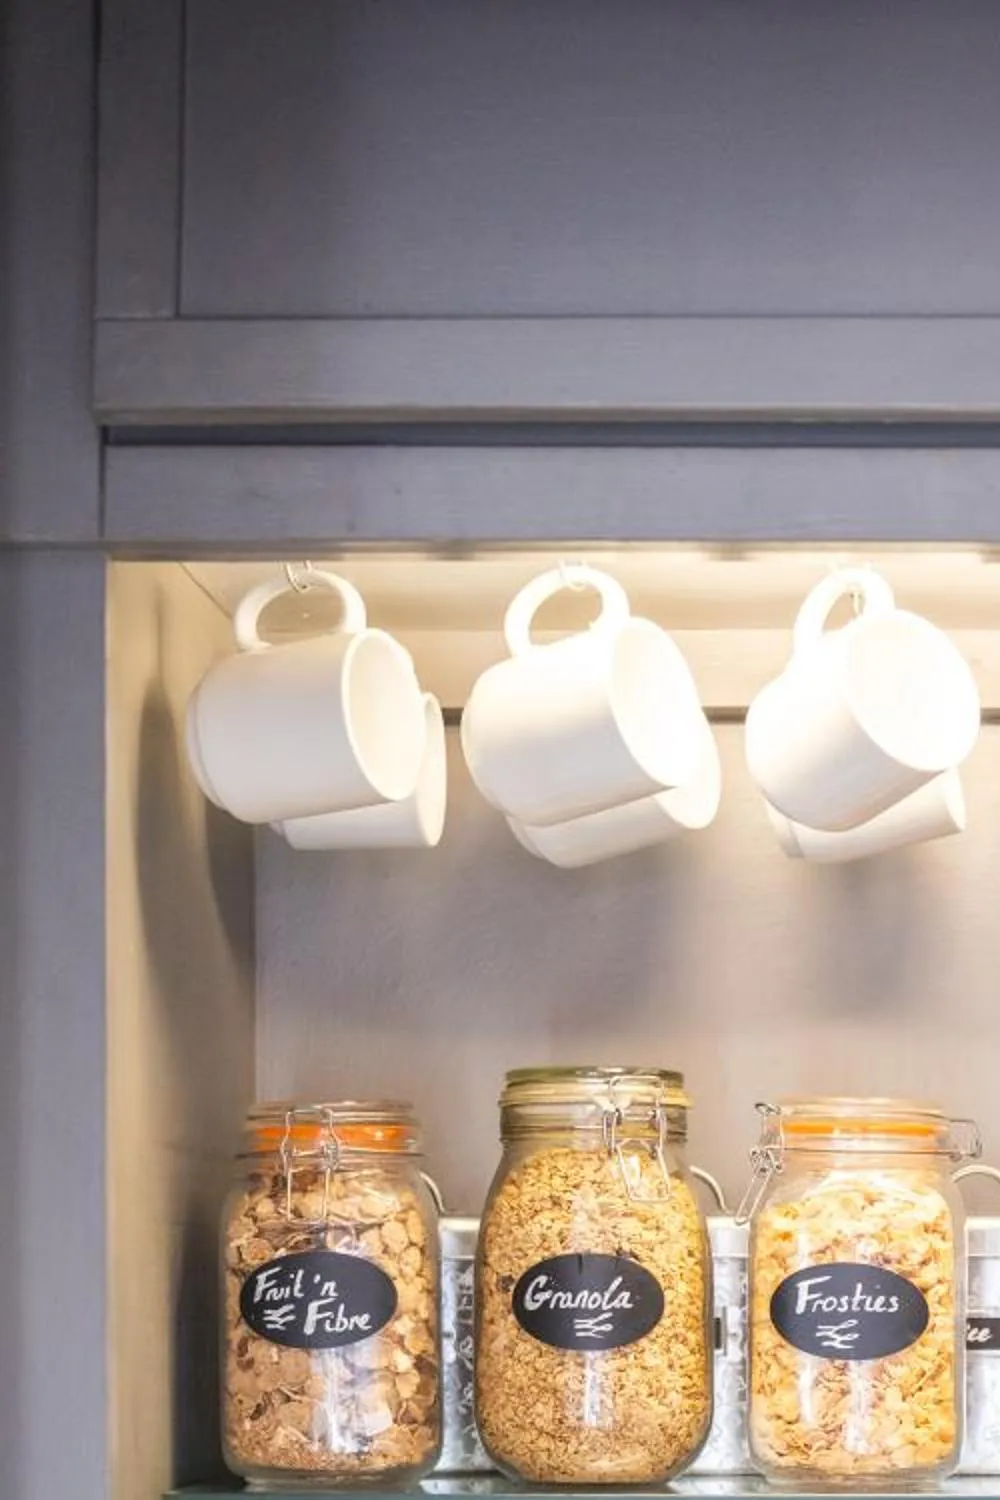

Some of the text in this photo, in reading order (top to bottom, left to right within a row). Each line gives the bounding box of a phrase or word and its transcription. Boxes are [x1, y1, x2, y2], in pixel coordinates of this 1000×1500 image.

[524, 1275, 634, 1311] Granola
[795, 1275, 899, 1315] Frosties
[303, 1297, 373, 1336] Fibre
